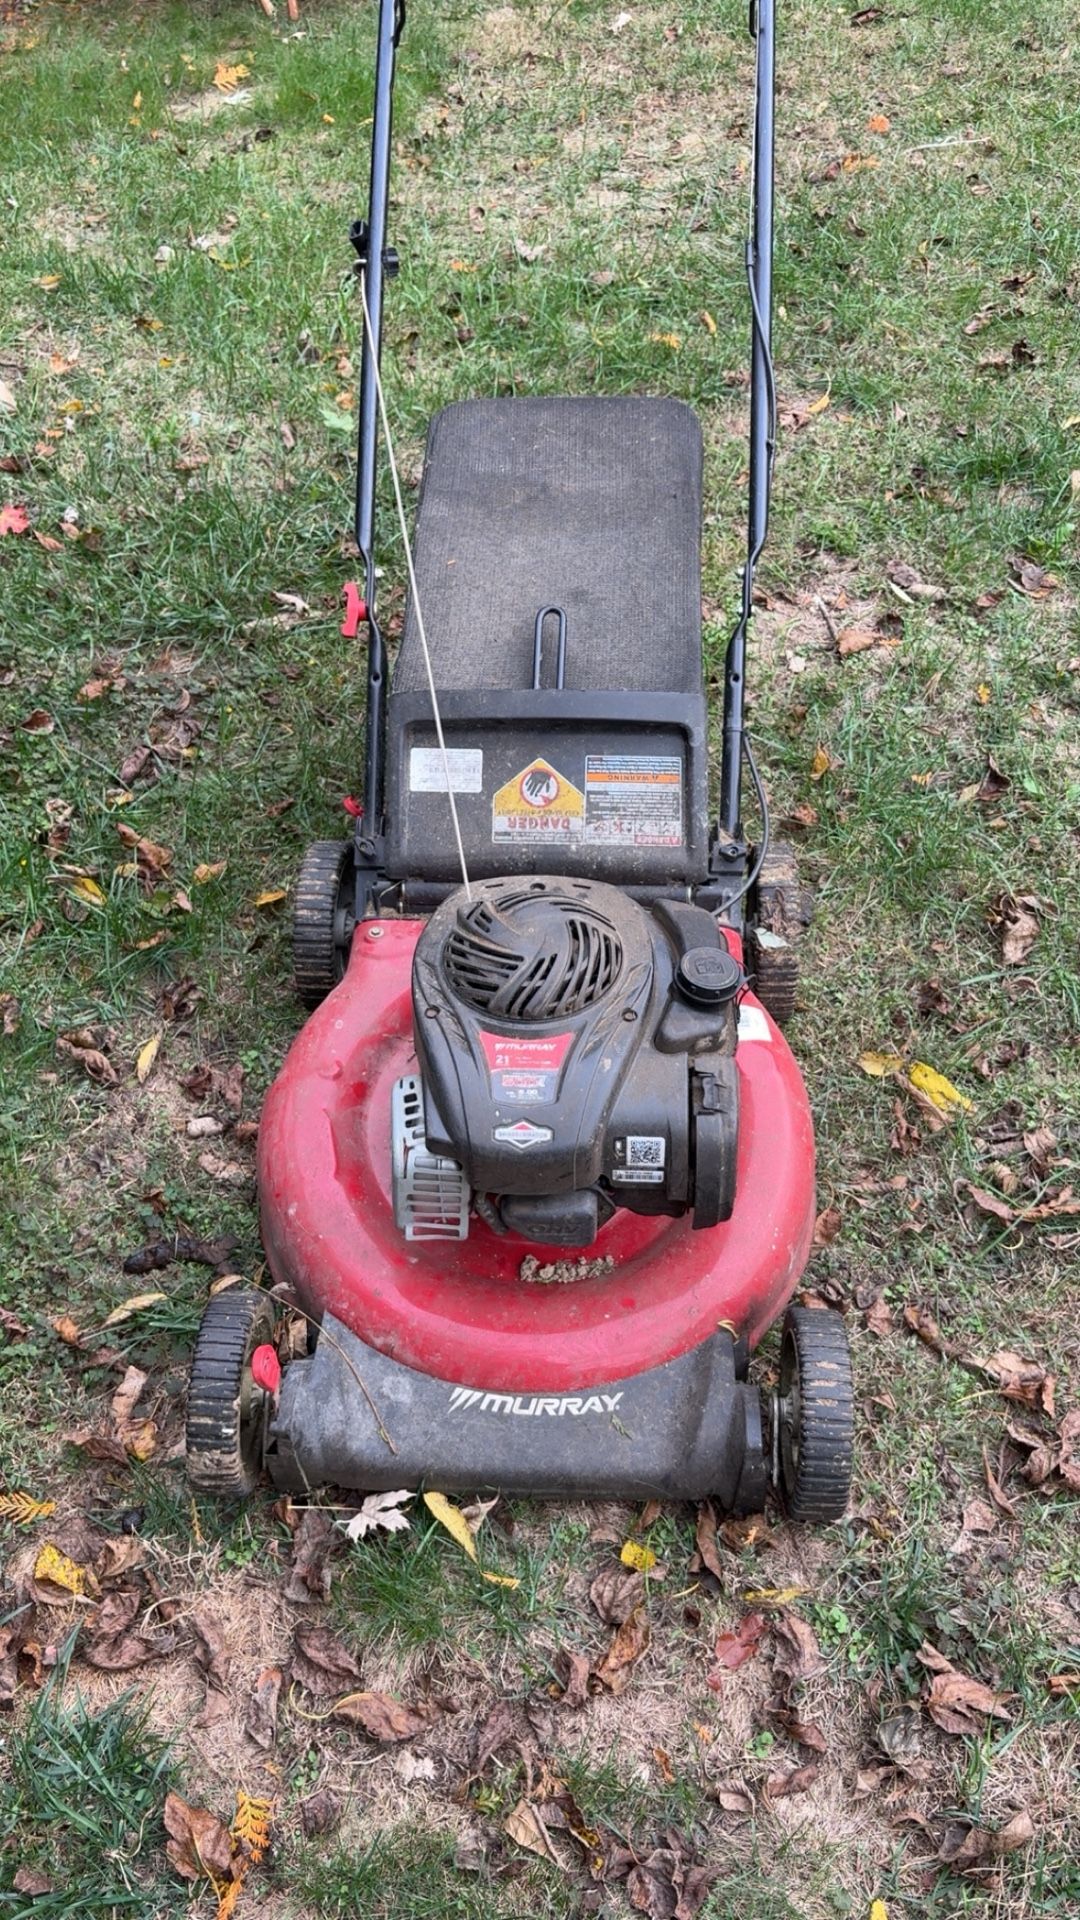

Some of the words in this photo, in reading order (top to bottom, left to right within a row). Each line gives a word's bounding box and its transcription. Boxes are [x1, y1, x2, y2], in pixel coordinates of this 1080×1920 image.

[607, 774, 649, 782] WARNING
[507, 817, 570, 830] DANGER
[479, 1391, 624, 1417] MURRAY
